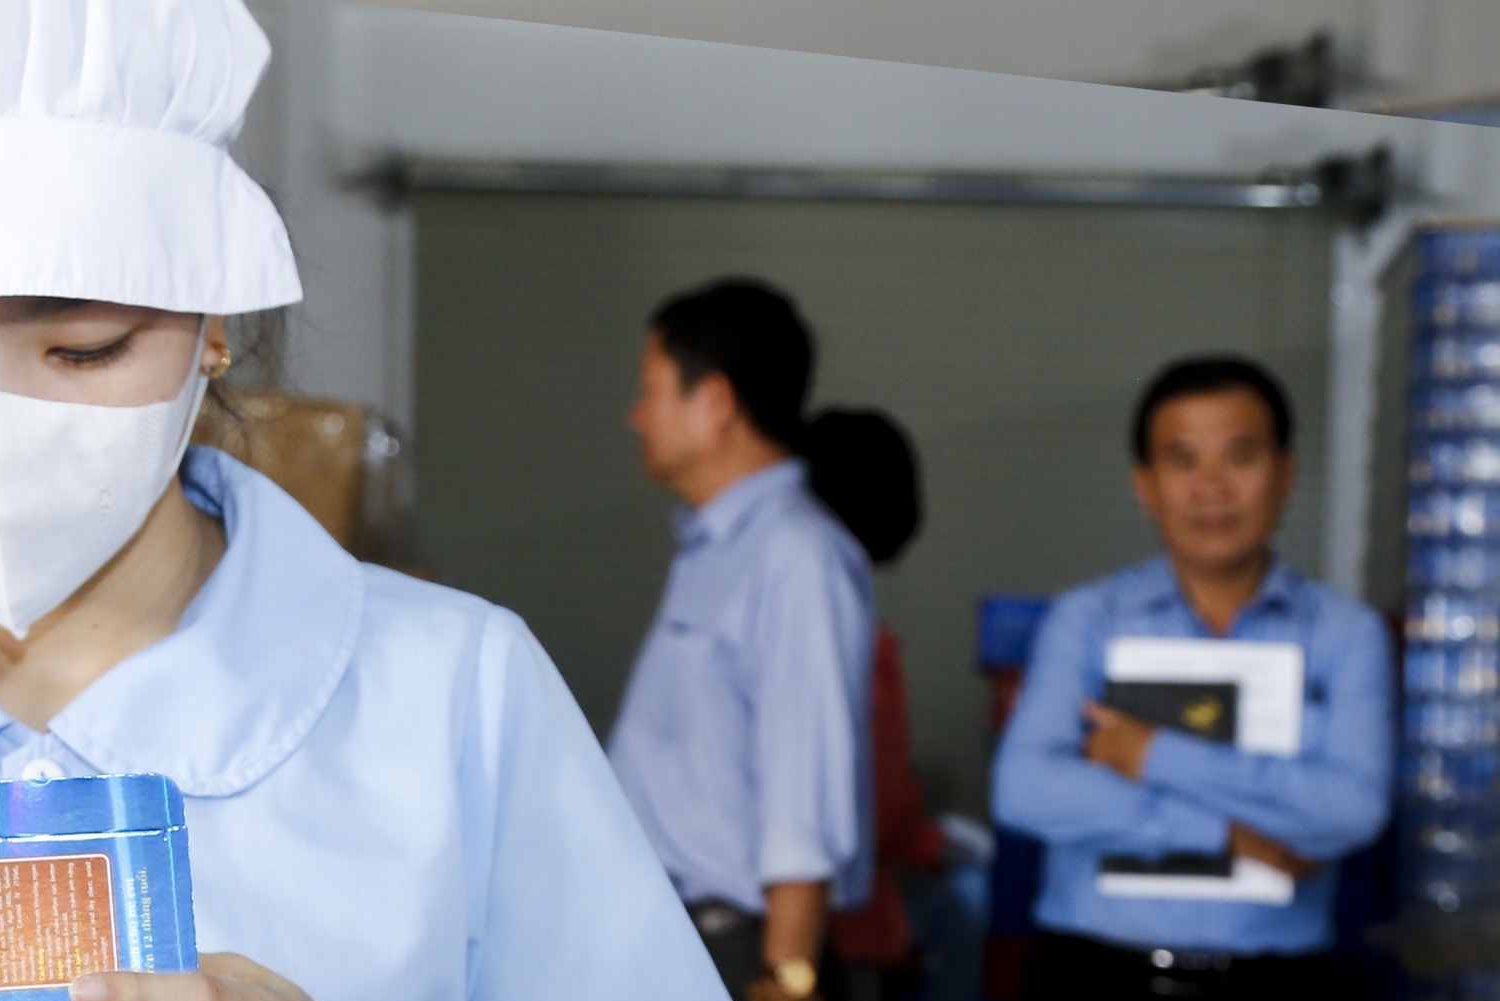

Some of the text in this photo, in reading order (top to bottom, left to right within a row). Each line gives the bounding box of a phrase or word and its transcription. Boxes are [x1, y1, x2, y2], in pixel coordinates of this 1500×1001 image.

[126, 878, 135, 897] em
[141, 897, 151, 931] tháng
[128, 921, 140, 940] cho
[145, 936, 153, 948] 12
[130, 947, 141, 972] ành
[145, 954, 154, 973] rên
